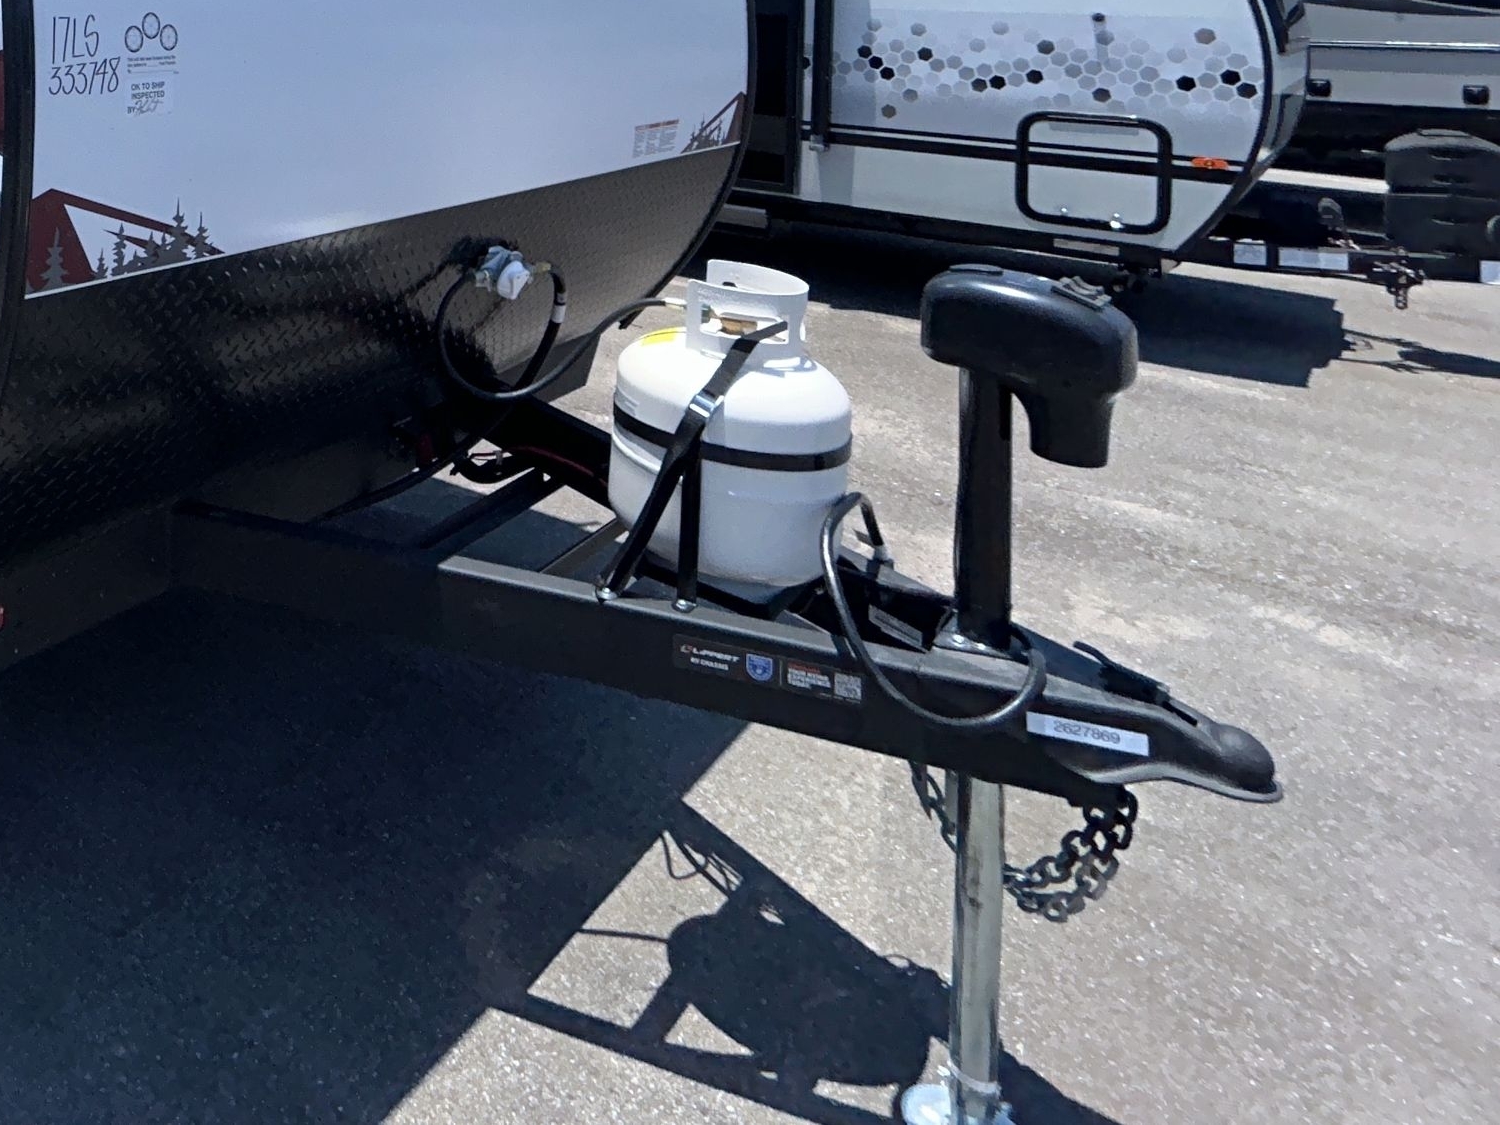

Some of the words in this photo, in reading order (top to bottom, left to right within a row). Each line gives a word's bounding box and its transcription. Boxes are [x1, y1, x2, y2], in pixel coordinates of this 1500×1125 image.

[52, 14, 100, 64] 17LS
[48, 56, 121, 95] 333748
[1053, 720, 1121, 745] 2627869
